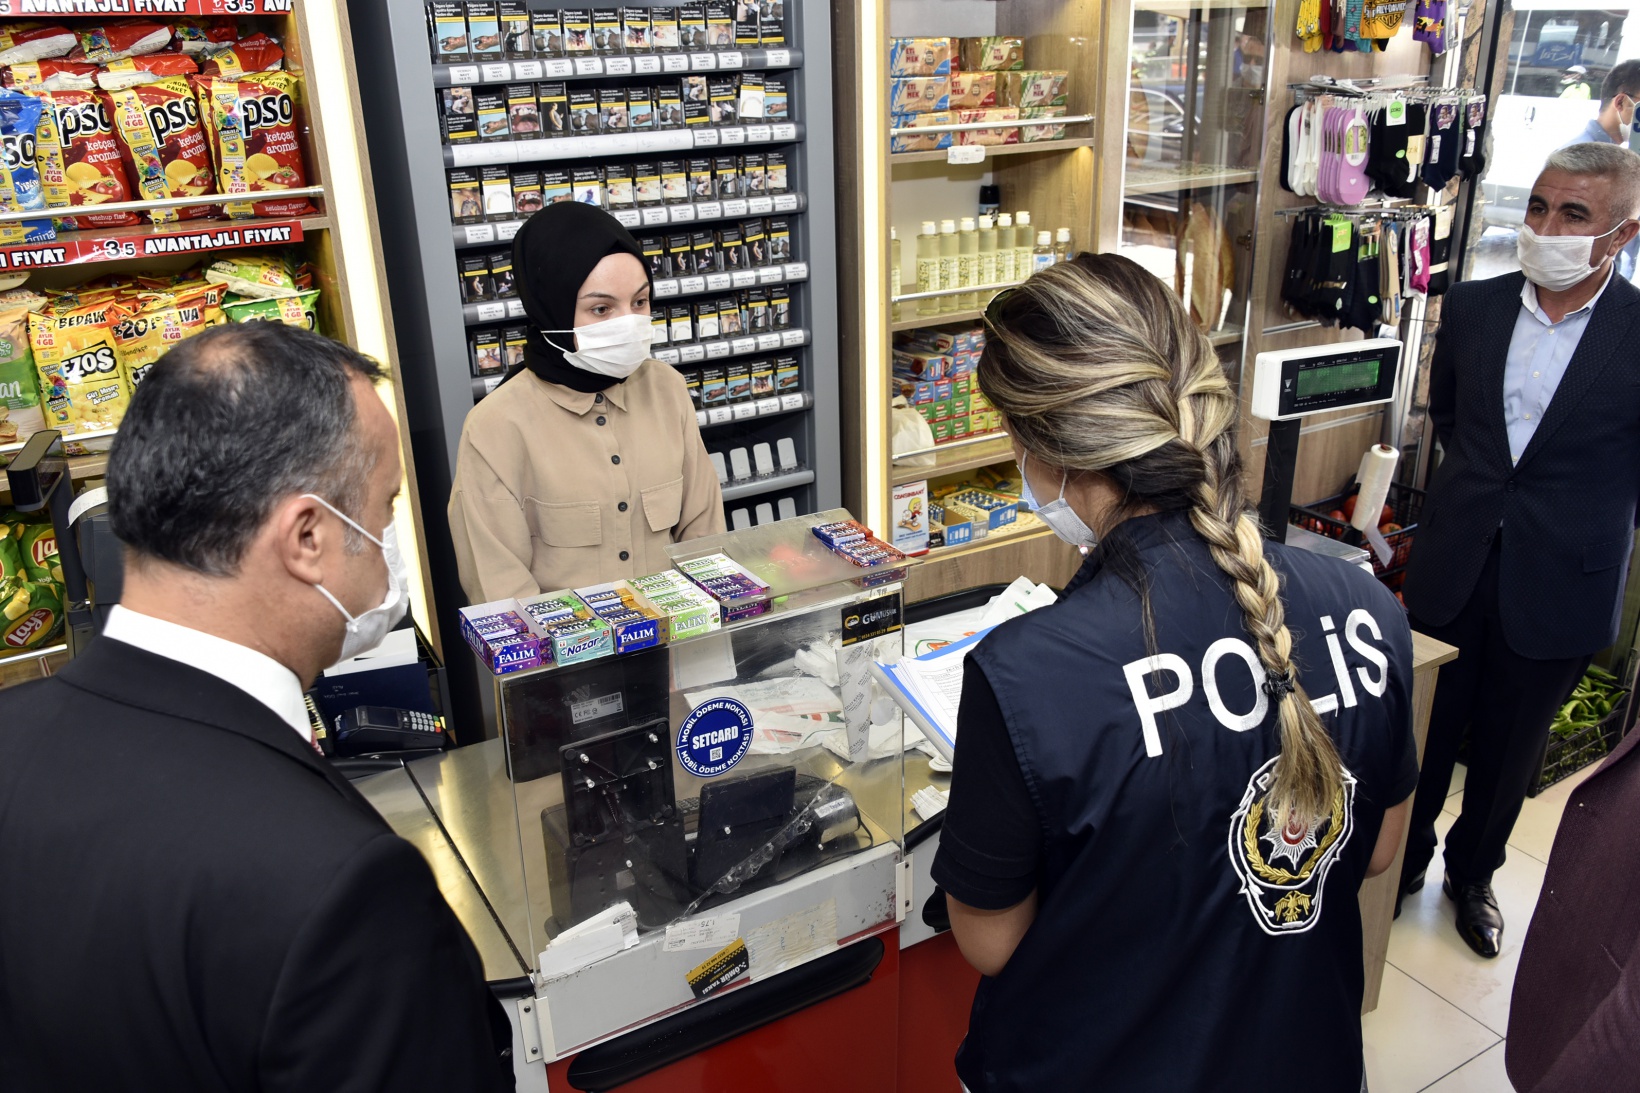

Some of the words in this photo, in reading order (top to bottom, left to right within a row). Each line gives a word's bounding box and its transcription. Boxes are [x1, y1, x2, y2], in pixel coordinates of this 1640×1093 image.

[21, 0, 129, 13] AVANTAJLI
[86, 139, 116, 152] ketçap
[265, 131, 295, 143] ketçap
[143, 231, 240, 255] AVANTAJLI
[59, 311, 107, 329] BEDAVA
[8, 610, 46, 645] Lay's
[675, 616, 707, 632] FALIM
[621, 628, 654, 643] FALIM
[499, 648, 535, 663] FALIM
[566, 637, 600, 657] Nazar
[682, 717, 697, 742] MOBİL
[696, 702, 724, 718] ÖDEME
[725, 703, 749, 727] NOKTASI
[692, 726, 739, 750] SETCARD
[681, 751, 698, 771] MOBİL
[699, 763, 727, 774] ÖDEME
[727, 733, 750, 766] NOKTASI
[721, 966, 741, 984] ÖMÜR
